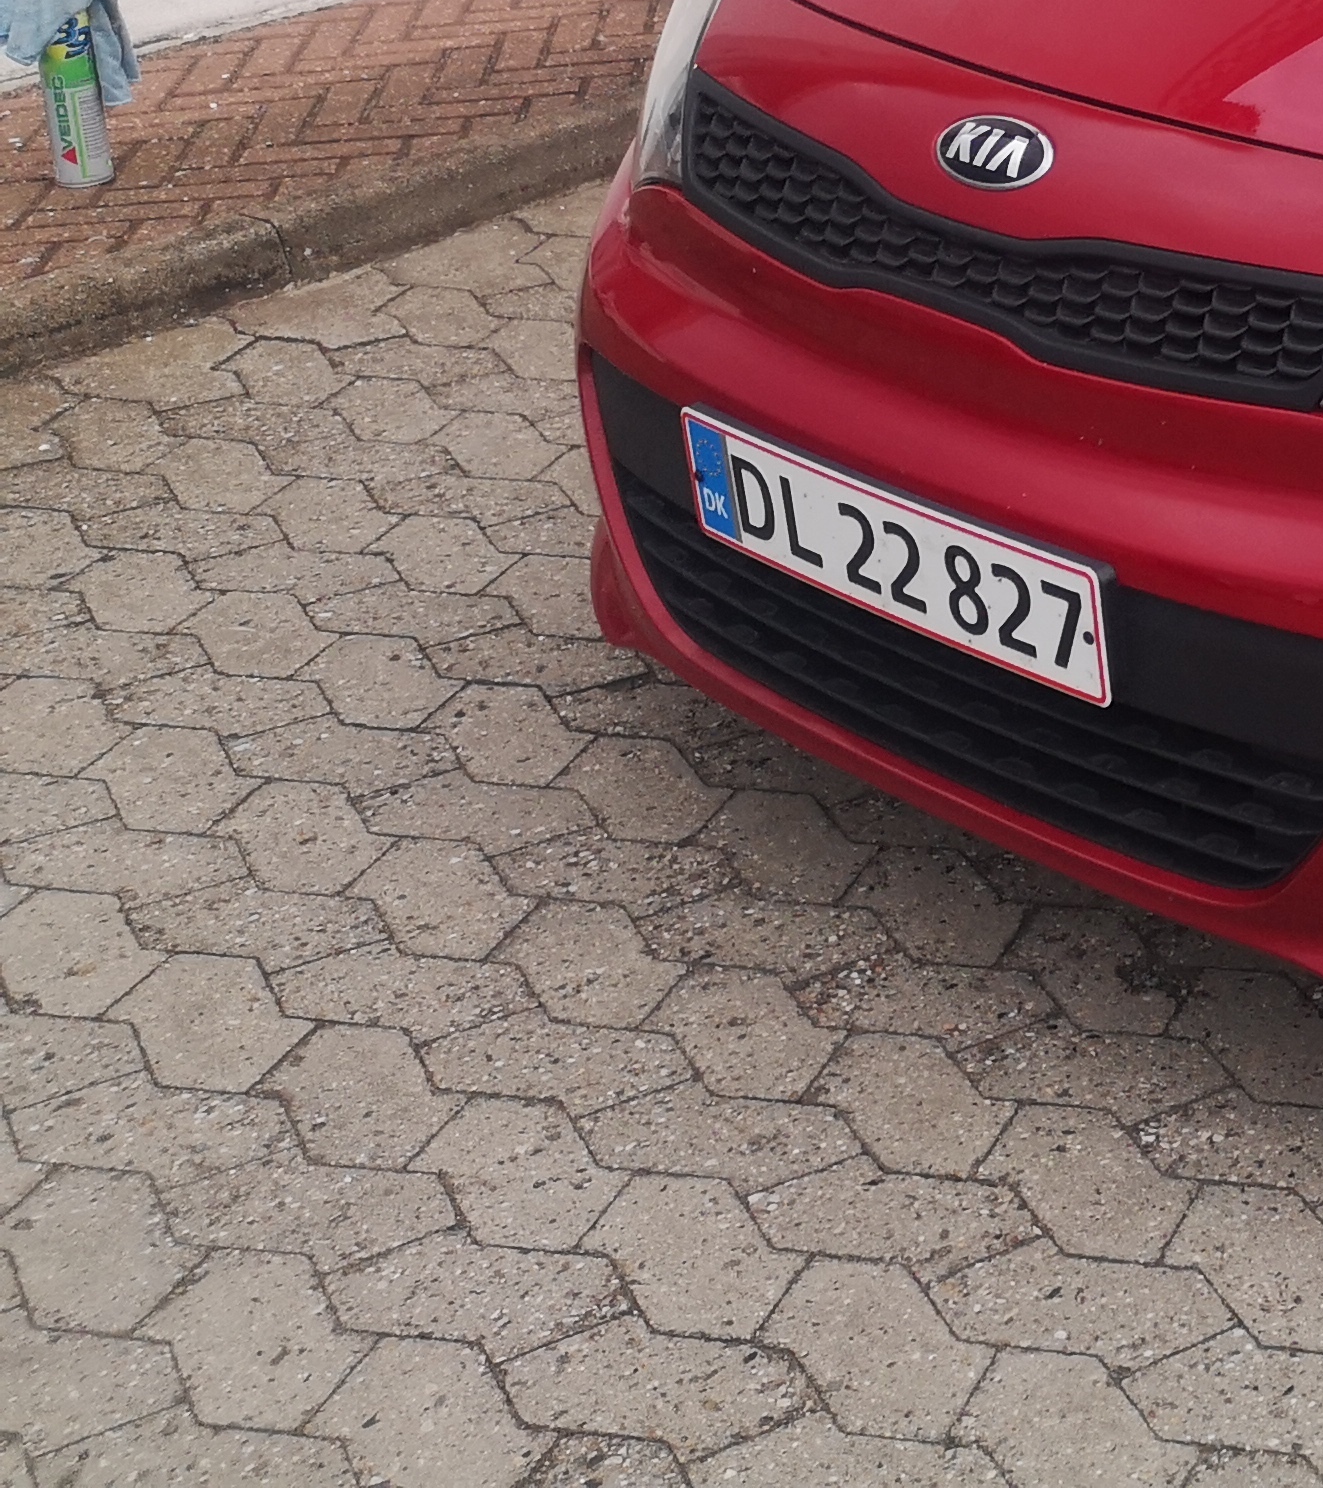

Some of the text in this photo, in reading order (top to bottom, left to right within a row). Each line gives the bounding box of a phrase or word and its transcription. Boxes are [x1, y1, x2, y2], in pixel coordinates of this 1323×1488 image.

[50, 75, 74, 152] VEIDEC
[946, 122, 1030, 178] KIA
[703, 486, 729, 520] DK
[731, 453, 1083, 669] DL 22 827
